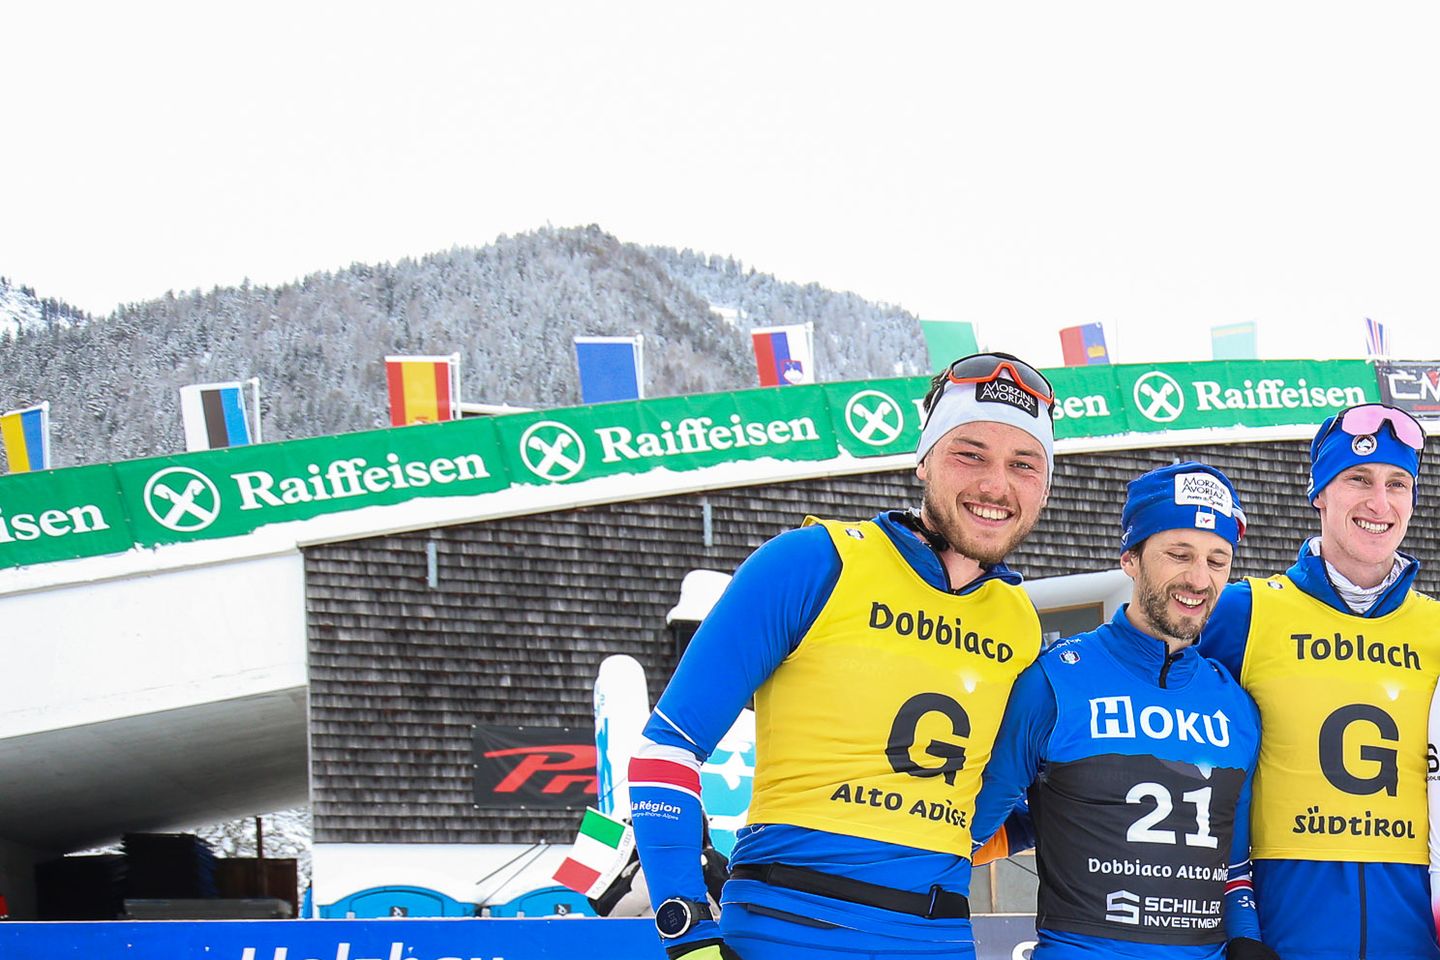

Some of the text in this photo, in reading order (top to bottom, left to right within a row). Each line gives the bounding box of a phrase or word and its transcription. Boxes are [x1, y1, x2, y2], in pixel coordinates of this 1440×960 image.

[980, 390, 1032, 410] AVORIAZ
[1192, 377, 1367, 414] Raiffeisen
[594, 416, 820, 463] Raiffeisen
[230, 450, 490, 511] Raiffeisen
[1182, 484, 1225, 500] AVORIAZ
[869, 602, 1013, 664] Dobbiaco
[1290, 632, 1422, 670] Toblach
[884, 692, 971, 787] G
[1089, 696, 1230, 748] HOKU
[1318, 703, 1400, 797] G
[639, 800, 681, 815] Région
[831, 783, 902, 812] ALTO
[1125, 782, 1219, 849] 21
[1088, 858, 1171, 878] Dobbiaco
[1176, 864, 1211, 881] ALTO
[1144, 897, 1221, 915] SCHILLER
[1144, 915, 1222, 929] INVESTMENT
